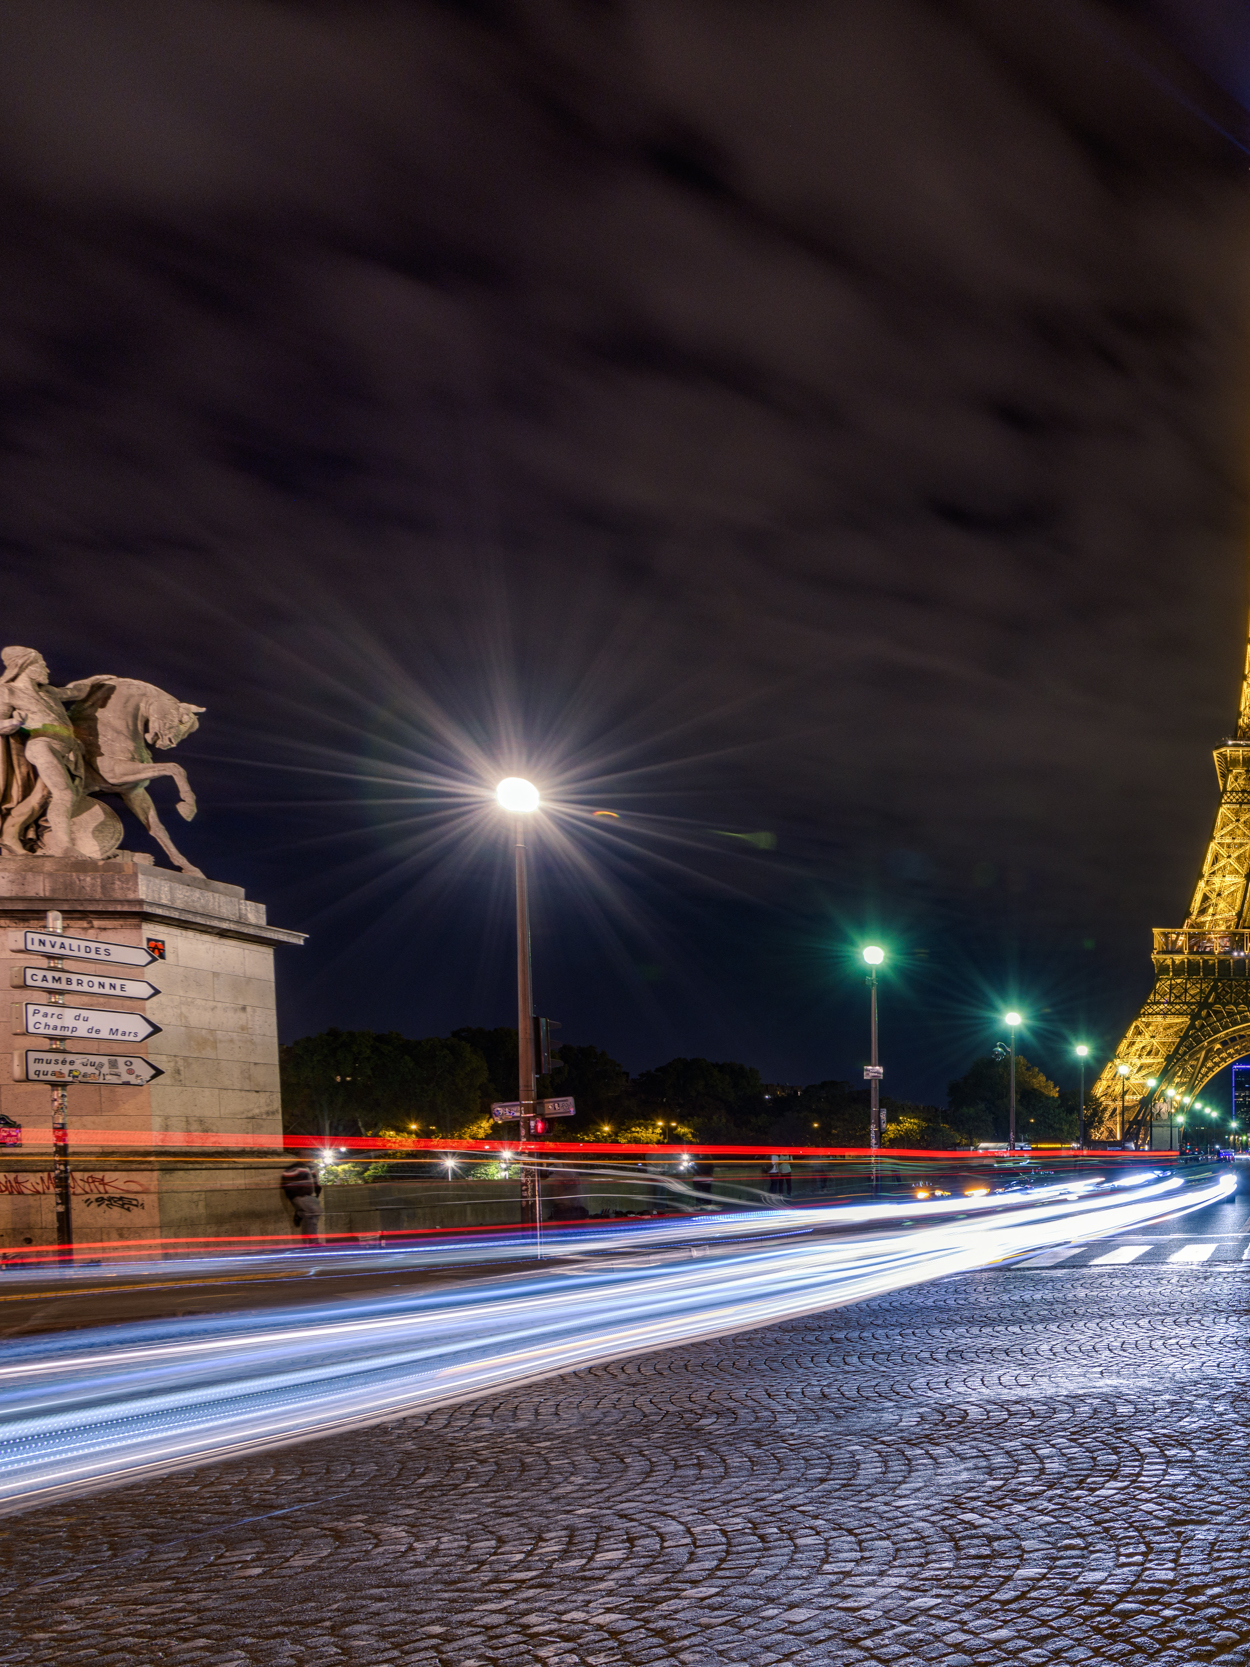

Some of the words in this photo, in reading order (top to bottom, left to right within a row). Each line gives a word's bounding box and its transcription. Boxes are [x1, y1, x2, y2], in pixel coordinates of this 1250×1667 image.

[31, 937, 111, 957] INVALIDES
[30, 973, 127, 992] CAMBRONNE
[32, 1008, 63, 1020] Parc
[74, 1013, 89, 1022] du
[33, 1021, 78, 1034] Champ
[87, 1026, 101, 1035] de
[108, 1028, 139, 1038] Mars
[33, 1057, 75, 1066] musée
